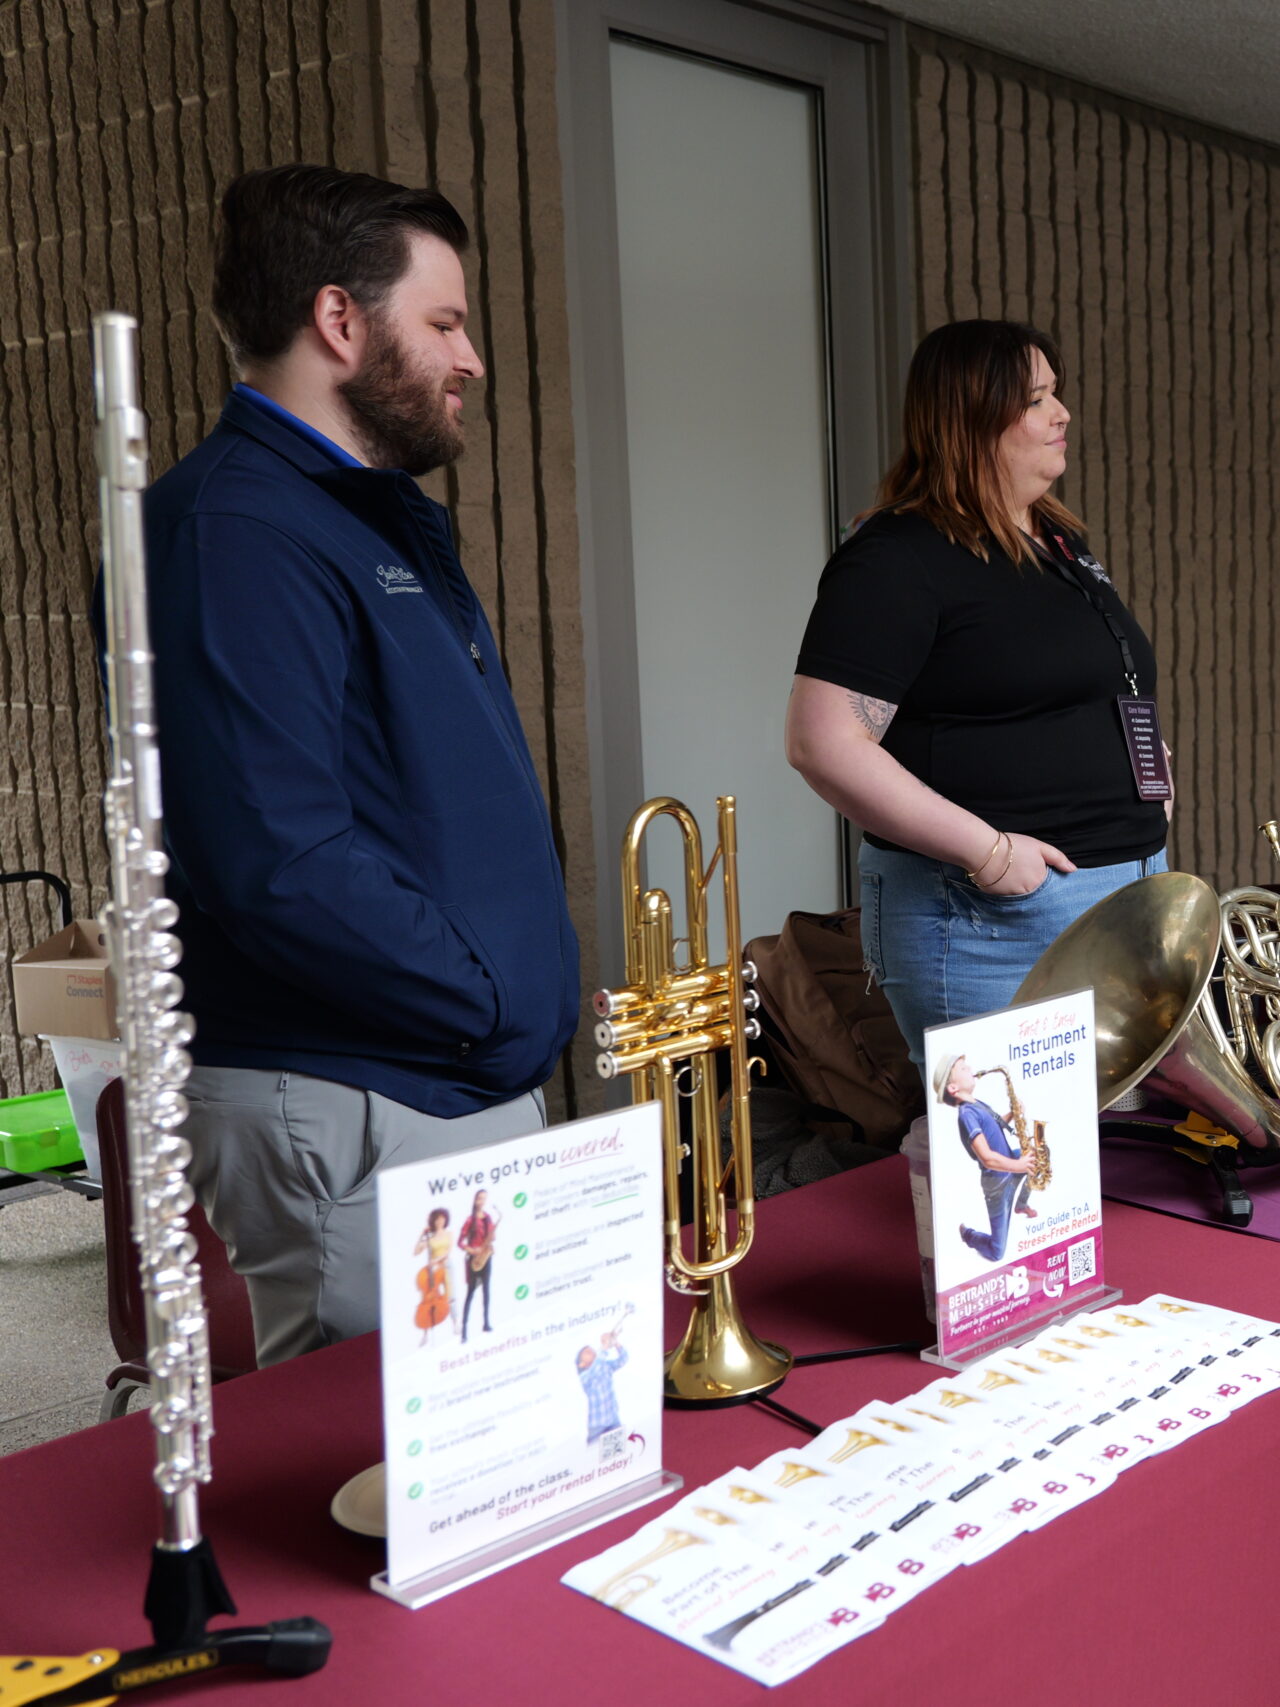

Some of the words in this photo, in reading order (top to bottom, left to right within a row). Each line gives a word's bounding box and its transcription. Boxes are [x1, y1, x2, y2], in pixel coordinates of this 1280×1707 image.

[66, 986, 104, 999] Connect
[1009, 1024, 1087, 1061] Instrument
[1022, 1050, 1076, 1081] Rentals
[428, 1169, 485, 1197] We've
[490, 1160, 519, 1186] got
[525, 1152, 557, 1178] you
[560, 1128, 625, 1163] covered.
[1017, 1226, 1070, 1252] Stress-Free
[1071, 1211, 1099, 1230] Rental
[1025, 1221, 1045, 1237] Your
[1047, 1212, 1071, 1228] Guide
[1072, 1206, 1083, 1218] To
[1084, 1202, 1091, 1213] A
[1046, 1251, 1067, 1269] RENT
[1048, 1266, 1067, 1283] NOW
[949, 1273, 1005, 1311] BERTRAND'S
[439, 1352, 470, 1374] Best
[473, 1334, 528, 1362] benefits
[530, 1328, 542, 1343] in
[544, 1321, 565, 1338] the
[567, 1301, 622, 1330] industry!
[429, 1516, 453, 1534] Get
[455, 1496, 496, 1524] ahead
[498, 1490, 513, 1509] of
[515, 1482, 535, 1500] the
[538, 1467, 574, 1490] class.
[496, 1500, 529, 1521] Start
[530, 1488, 558, 1511] your
[559, 1470, 596, 1496] rental
[597, 1453, 634, 1479] today!
[119, 1652, 211, 1688] HERCULES
